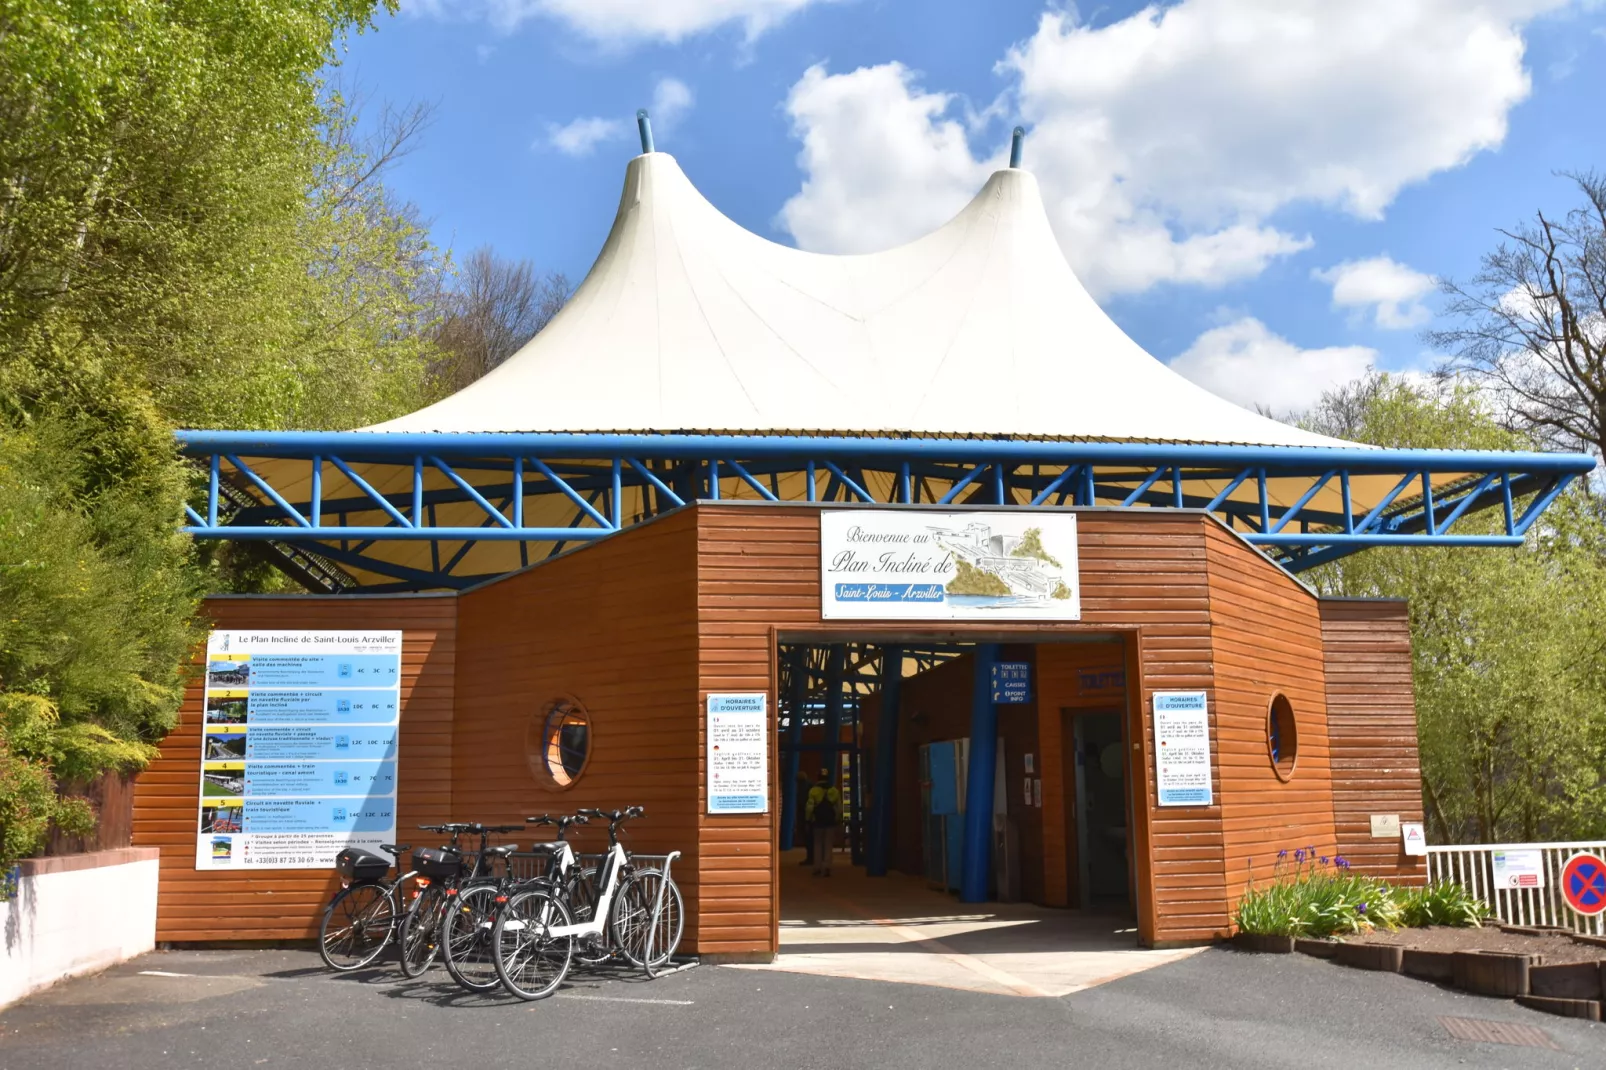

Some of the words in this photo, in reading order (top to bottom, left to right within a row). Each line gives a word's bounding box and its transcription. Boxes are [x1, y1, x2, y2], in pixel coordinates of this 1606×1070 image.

[846, 526, 909, 543] Bienvenue
[913, 534, 929, 543] au
[827, 551, 868, 573] Plan
[872, 551, 932, 573] Incliné
[934, 551, 953, 573] de
[836, 584, 892, 600] Saint-Louis
[901, 584, 943, 600] Arzviller
